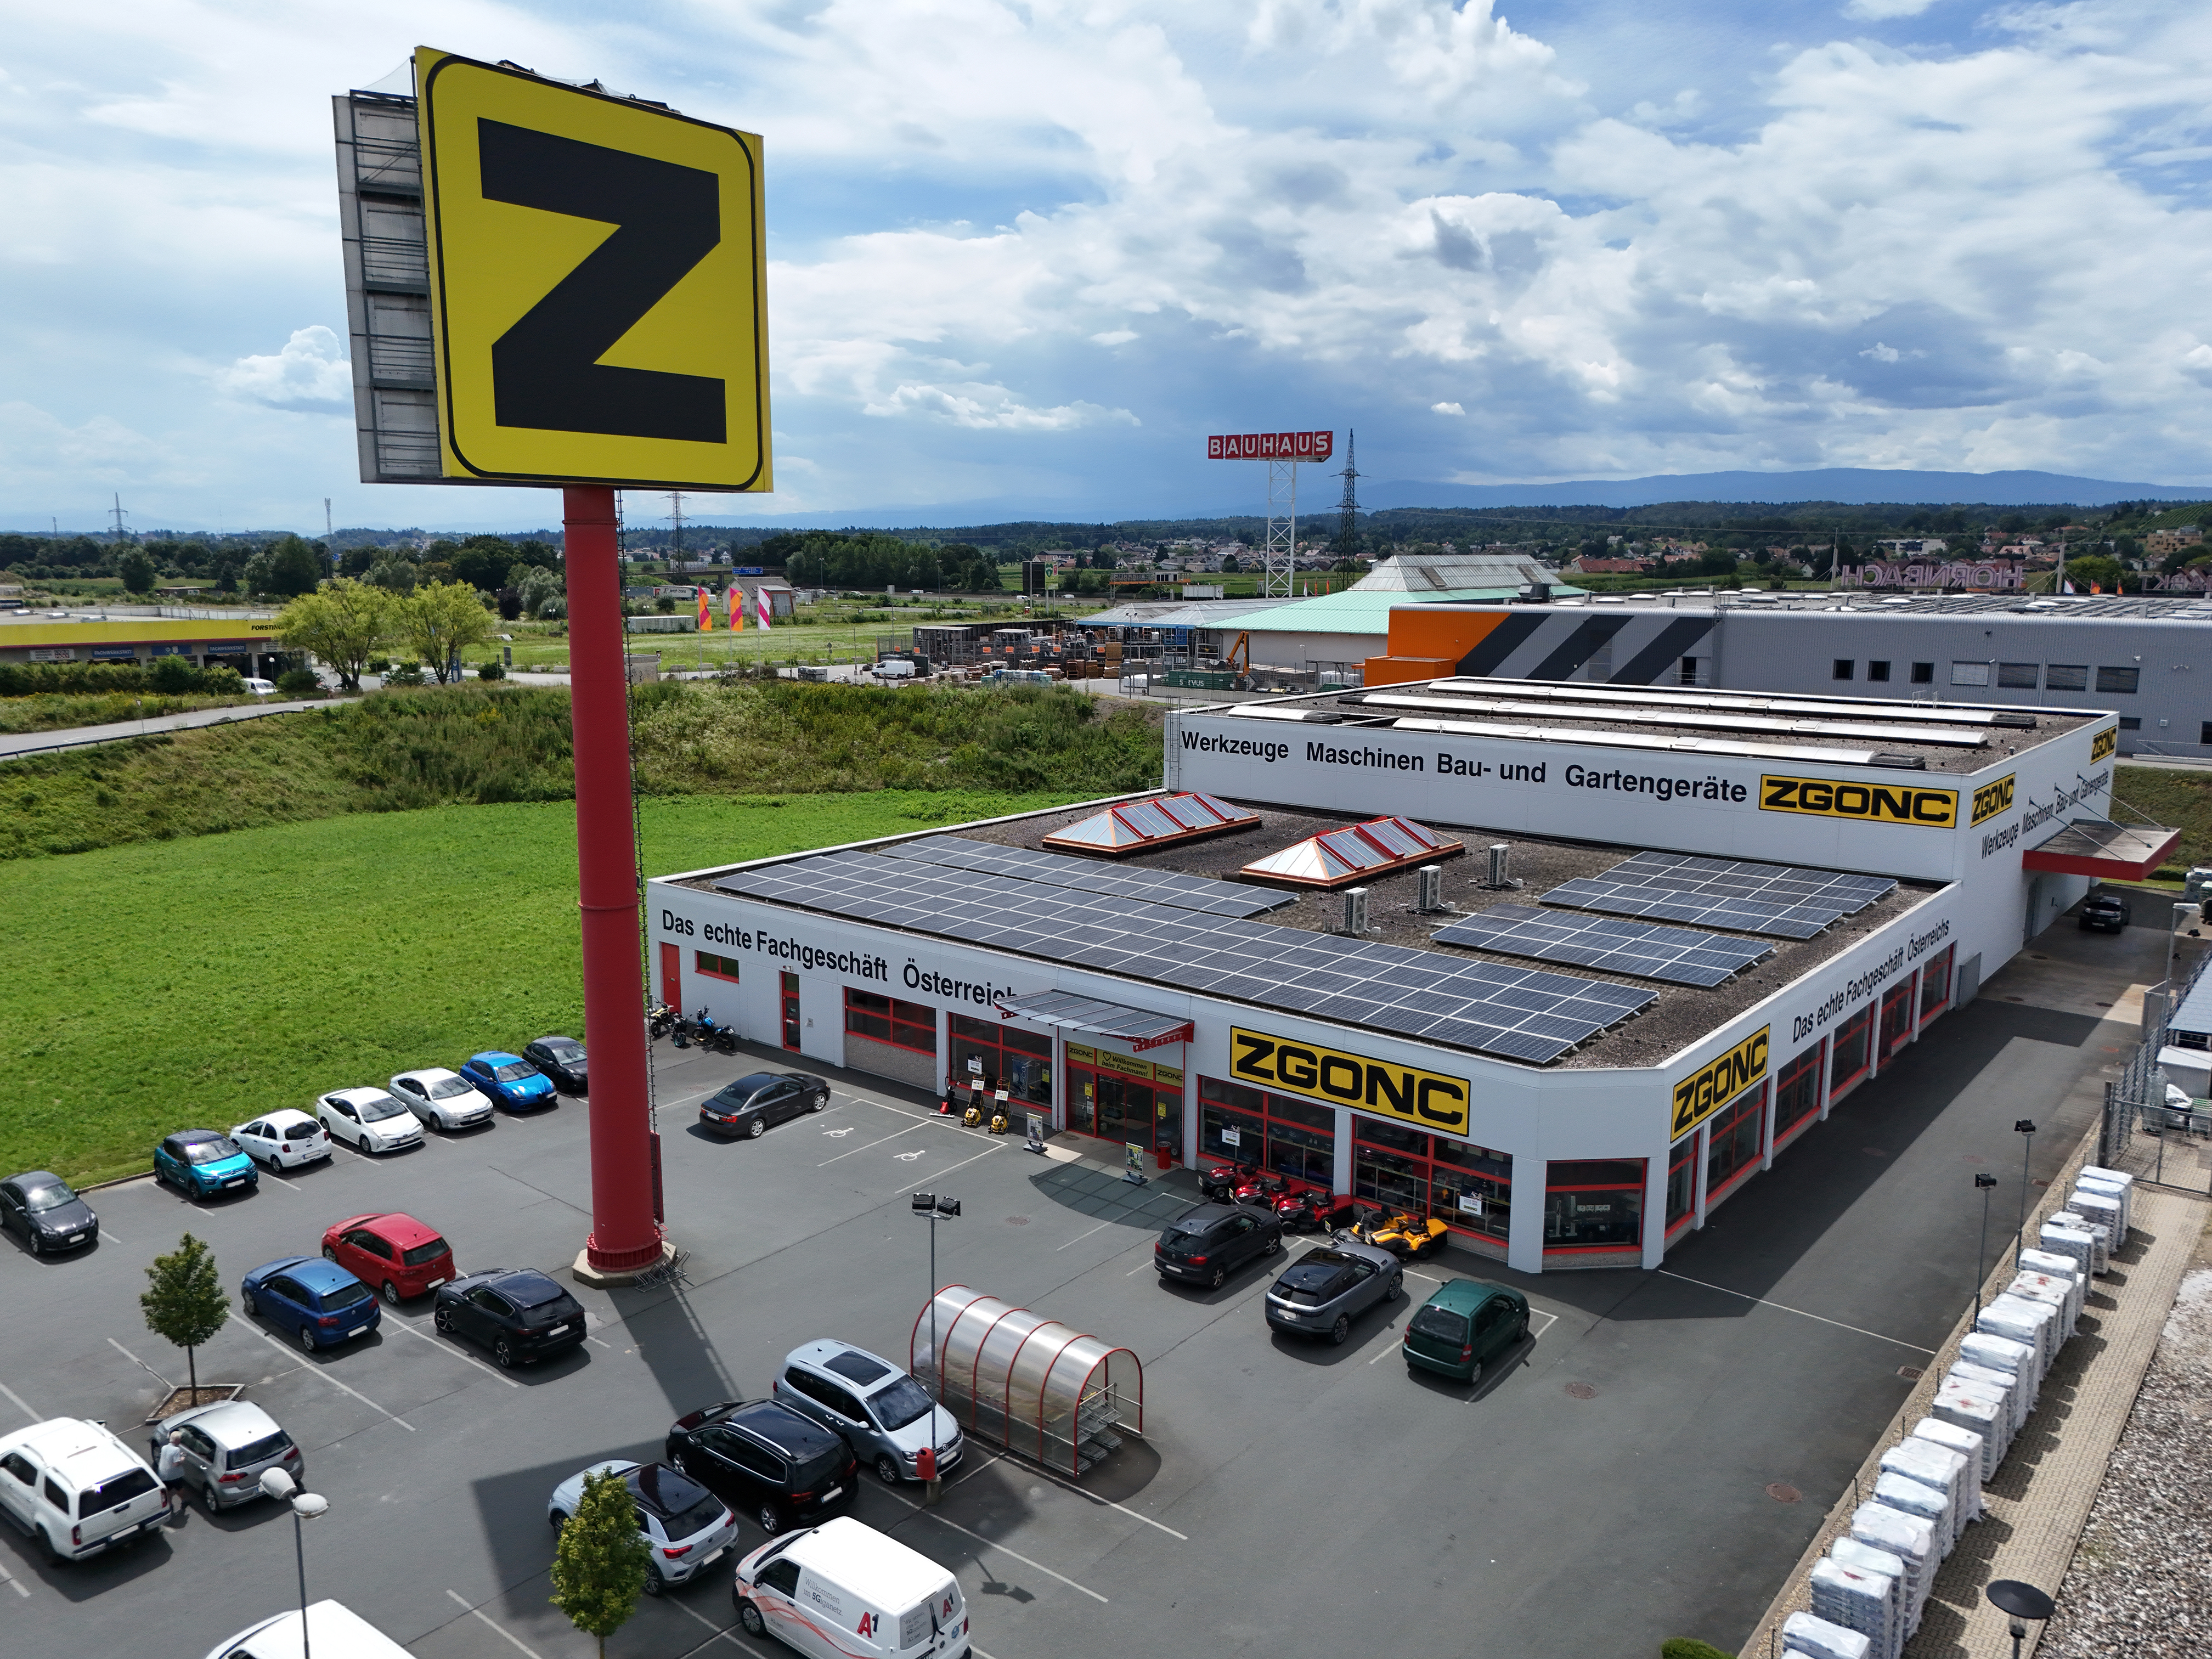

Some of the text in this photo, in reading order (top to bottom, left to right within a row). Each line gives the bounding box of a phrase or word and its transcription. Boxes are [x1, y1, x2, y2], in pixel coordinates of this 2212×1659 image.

[478, 117, 727, 444] Z
[1210, 435, 1328, 455] BAUHAUS
[1181, 731, 1747, 803] Werkzeuge Maschinen Bau- und Gartengeräte
[1765, 780, 1951, 822] ZGONC
[1972, 777, 2014, 822] ZGONC
[1982, 822, 2018, 859] Werkzeuge
[2022, 803, 2053, 835] Maschinen
[2056, 794, 2068, 815] Bau-
[2069, 783, 2079, 806] und
[663, 910, 695, 936] Das
[704, 923, 752, 950] echte
[757, 930, 888, 981] Fachgeschäft
[1793, 918, 1950, 1043] Das echte Fachgeschäft Österreichs
[1069, 1047, 1093, 1058] ZGONC
[1102, 1060, 1148, 1077] beim Fachmann!
[1112, 1056, 1147, 1069] Willkommen
[1158, 1070, 1183, 1081] ZGONC
[1237, 1034, 1463, 1125] ZGONC
[1674, 1033, 1767, 1133] ZGONC
[804, 1588, 843, 1616] im 5Giganetz.
[805, 1577, 840, 1604] Willkommen
[943, 1592, 953, 1618] A1
[857, 1611, 879, 1638] A1
